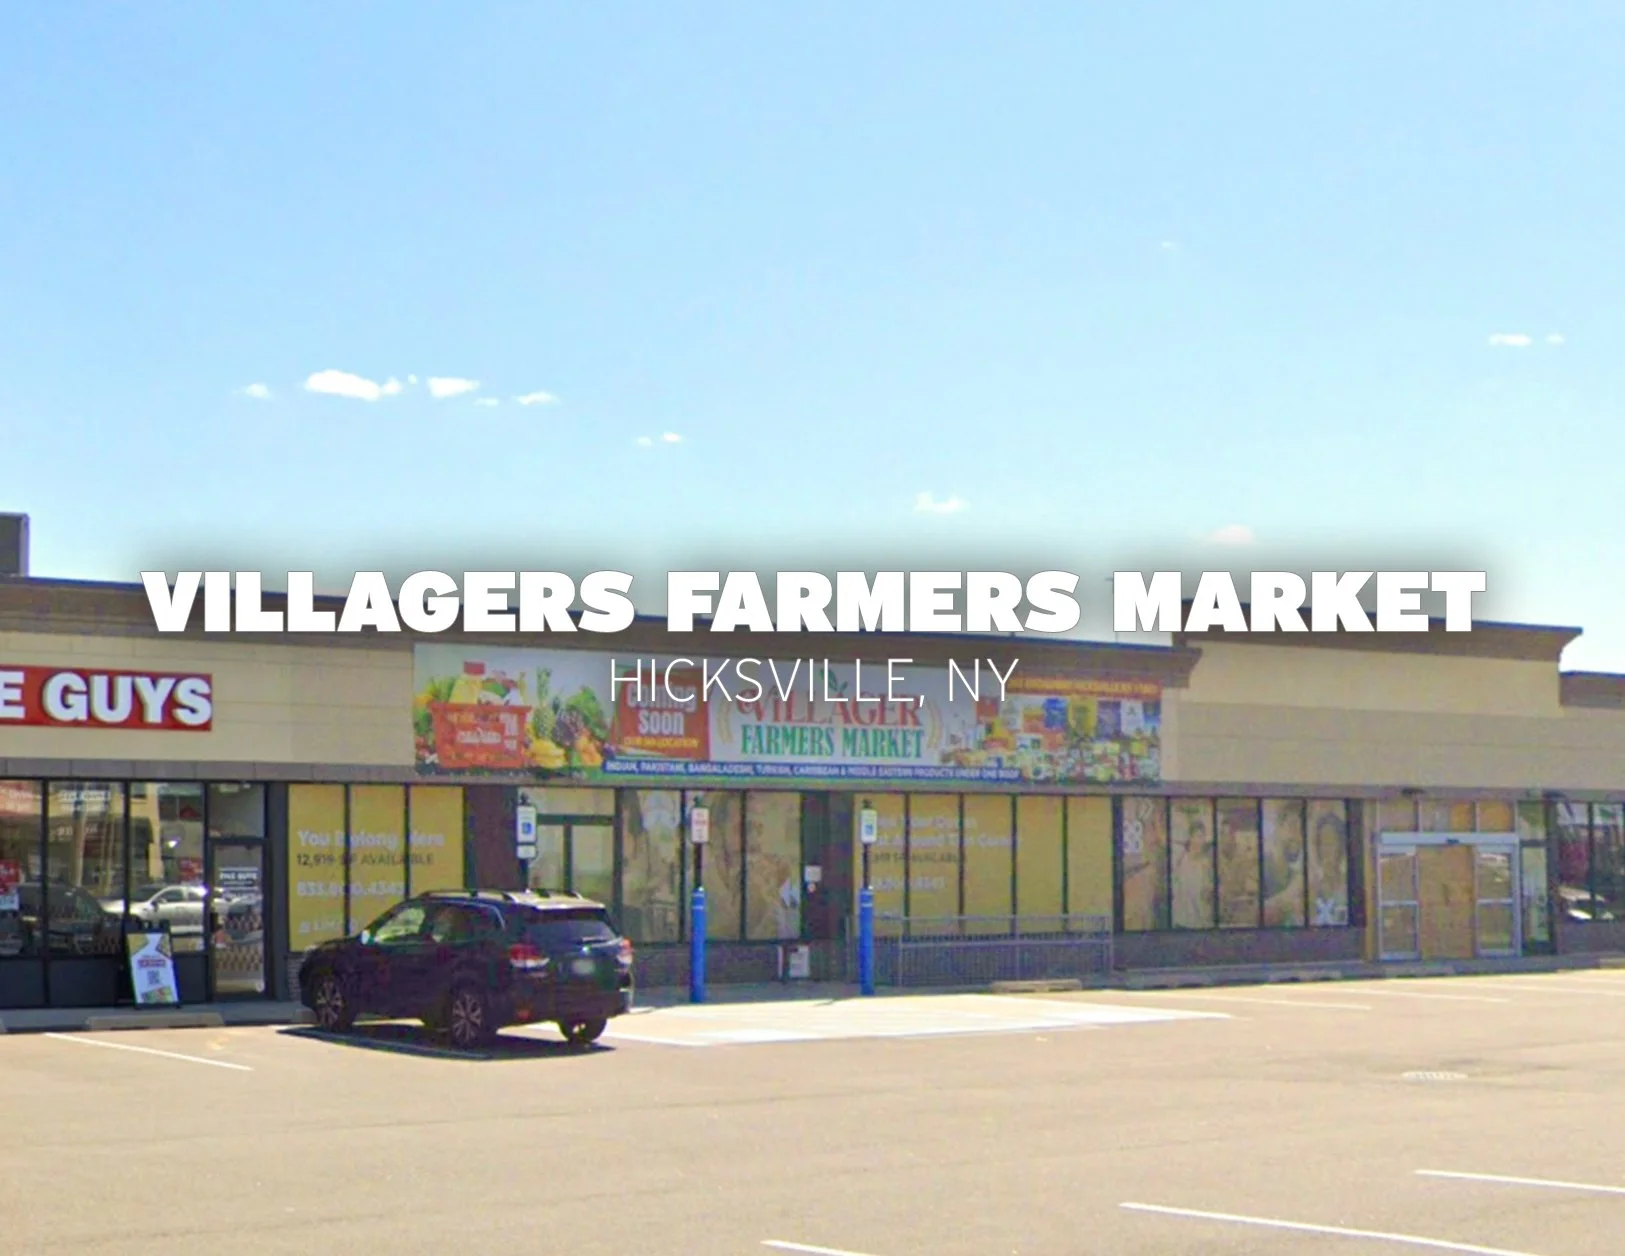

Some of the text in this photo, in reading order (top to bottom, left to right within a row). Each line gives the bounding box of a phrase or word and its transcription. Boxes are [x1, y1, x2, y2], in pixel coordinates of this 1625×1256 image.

[0, 671, 212, 726] E GUYS
[741, 723, 924, 759] FARMERS MARKET
